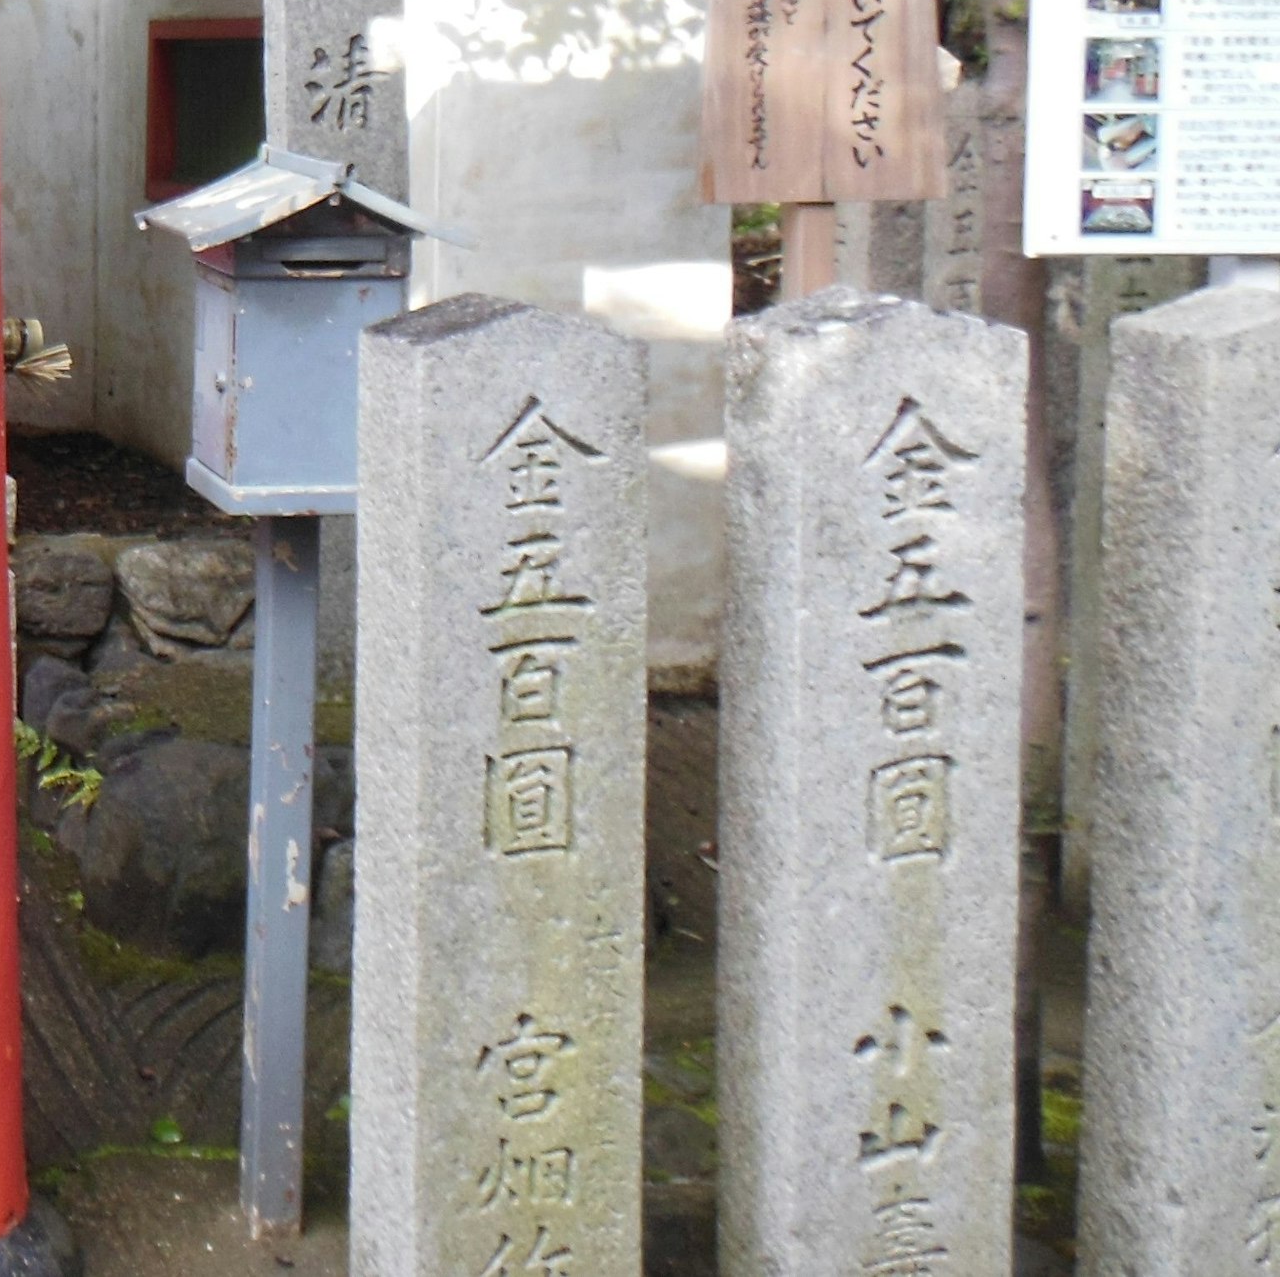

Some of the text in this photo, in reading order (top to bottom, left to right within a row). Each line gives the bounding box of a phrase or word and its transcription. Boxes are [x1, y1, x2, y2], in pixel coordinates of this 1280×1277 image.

[303, 33, 390, 178] 清
[476, 394, 608, 856] 金五百圓
[859, 396, 980, 862] 金五百圓
